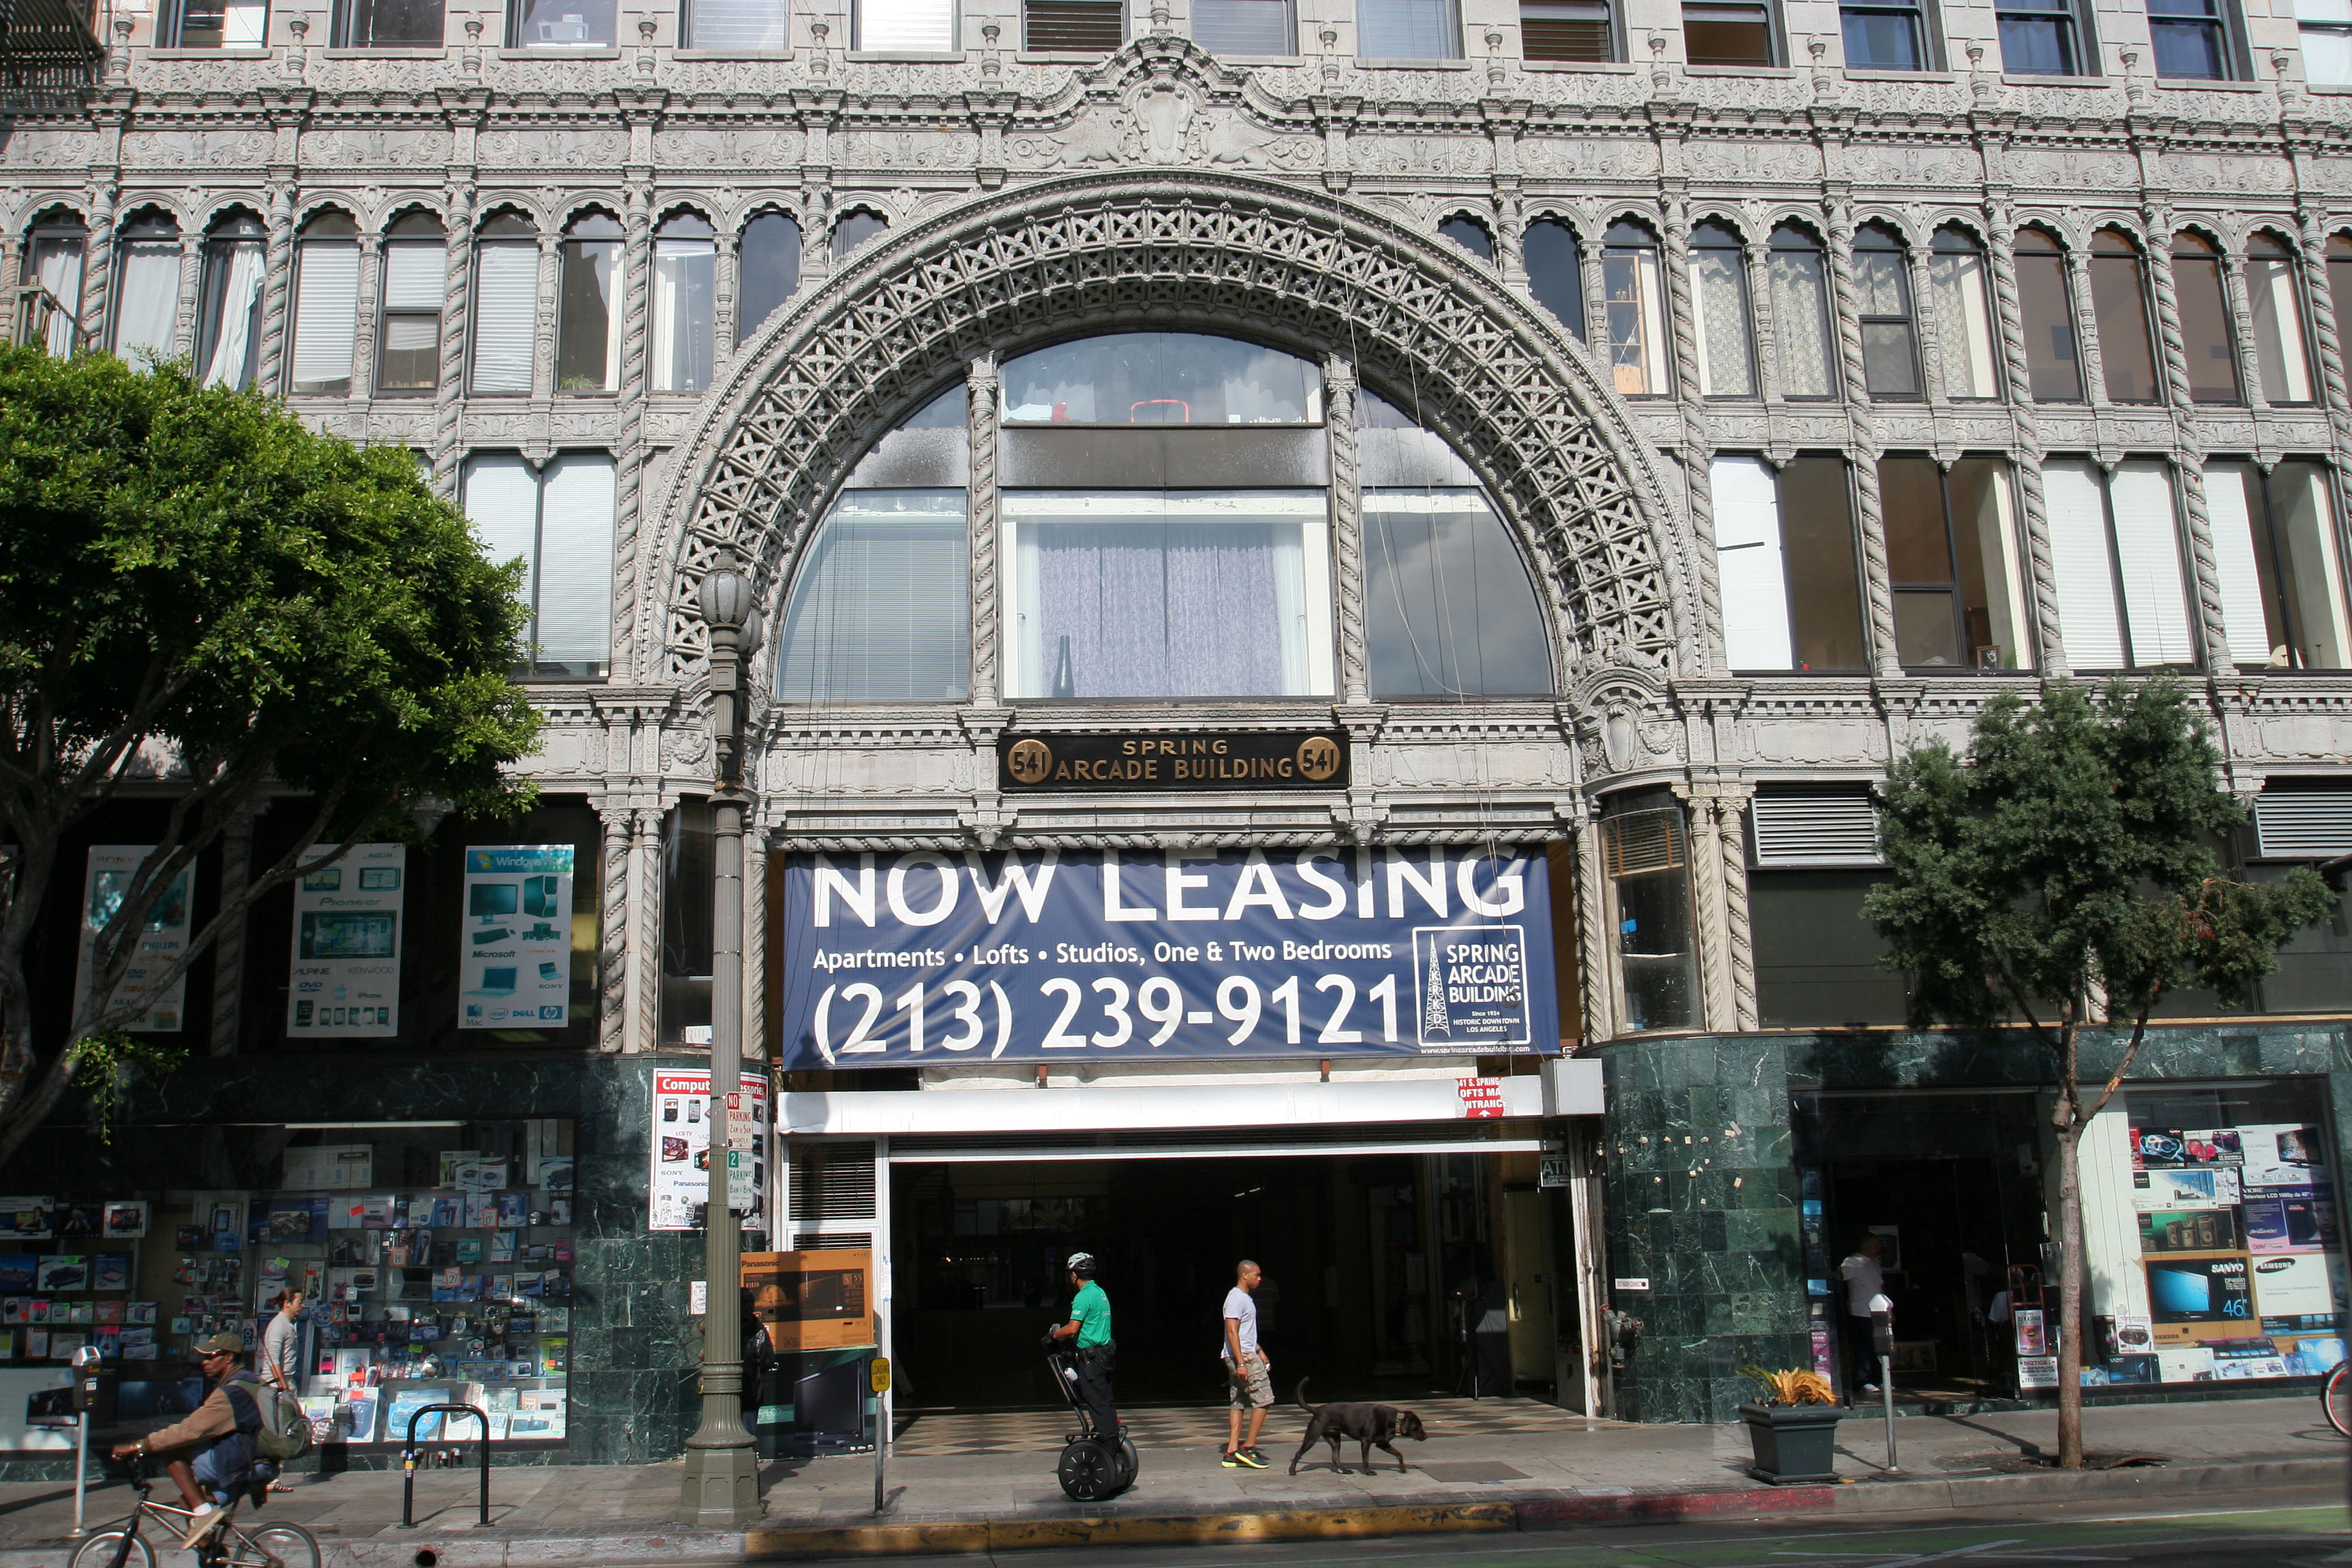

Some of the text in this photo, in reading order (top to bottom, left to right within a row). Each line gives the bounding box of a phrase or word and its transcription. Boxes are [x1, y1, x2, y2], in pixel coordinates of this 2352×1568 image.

[1122, 740, 1228, 756] SPRING
[1013, 750, 1046, 774] 541
[1301, 748, 1335, 772] 541
[1055, 757, 1292, 781] ARCADE BUILDING
[496, 856, 542, 867] Windows
[813, 845, 1525, 927] NOW LEASING
[319, 898, 382, 906] Pioneer
[141, 941, 180, 949] PHILIPS
[472, 950, 516, 958] Microsoft
[813, 940, 1392, 973] Apartments Lofts Studios, One & Two Bedrooms
[1446, 944, 1520, 964] SPRING
[1448, 965, 1520, 984] ARCADE
[1449, 985, 1522, 1004] BUILDING
[814, 973, 1397, 1065] (213) 239-9121
[1458, 1079, 1467, 1087] 41
[1476, 1077, 1499, 1086] SPRING
[1460, 1088, 1484, 1098] OFTS
[728, 1094, 738, 1108] NO
[1465, 1099, 1503, 1109] NTRANC
[730, 1111, 751, 1122] PARKING
[730, 1153, 736, 1166] 2
[742, 1260, 780, 1268] Panasonic
[2211, 1262, 2244, 1273] SANYO
[2223, 1298, 2247, 1317] 46"
[872, 1365, 889, 1375] LOADING
[876, 1376, 885, 1385] ONLY
